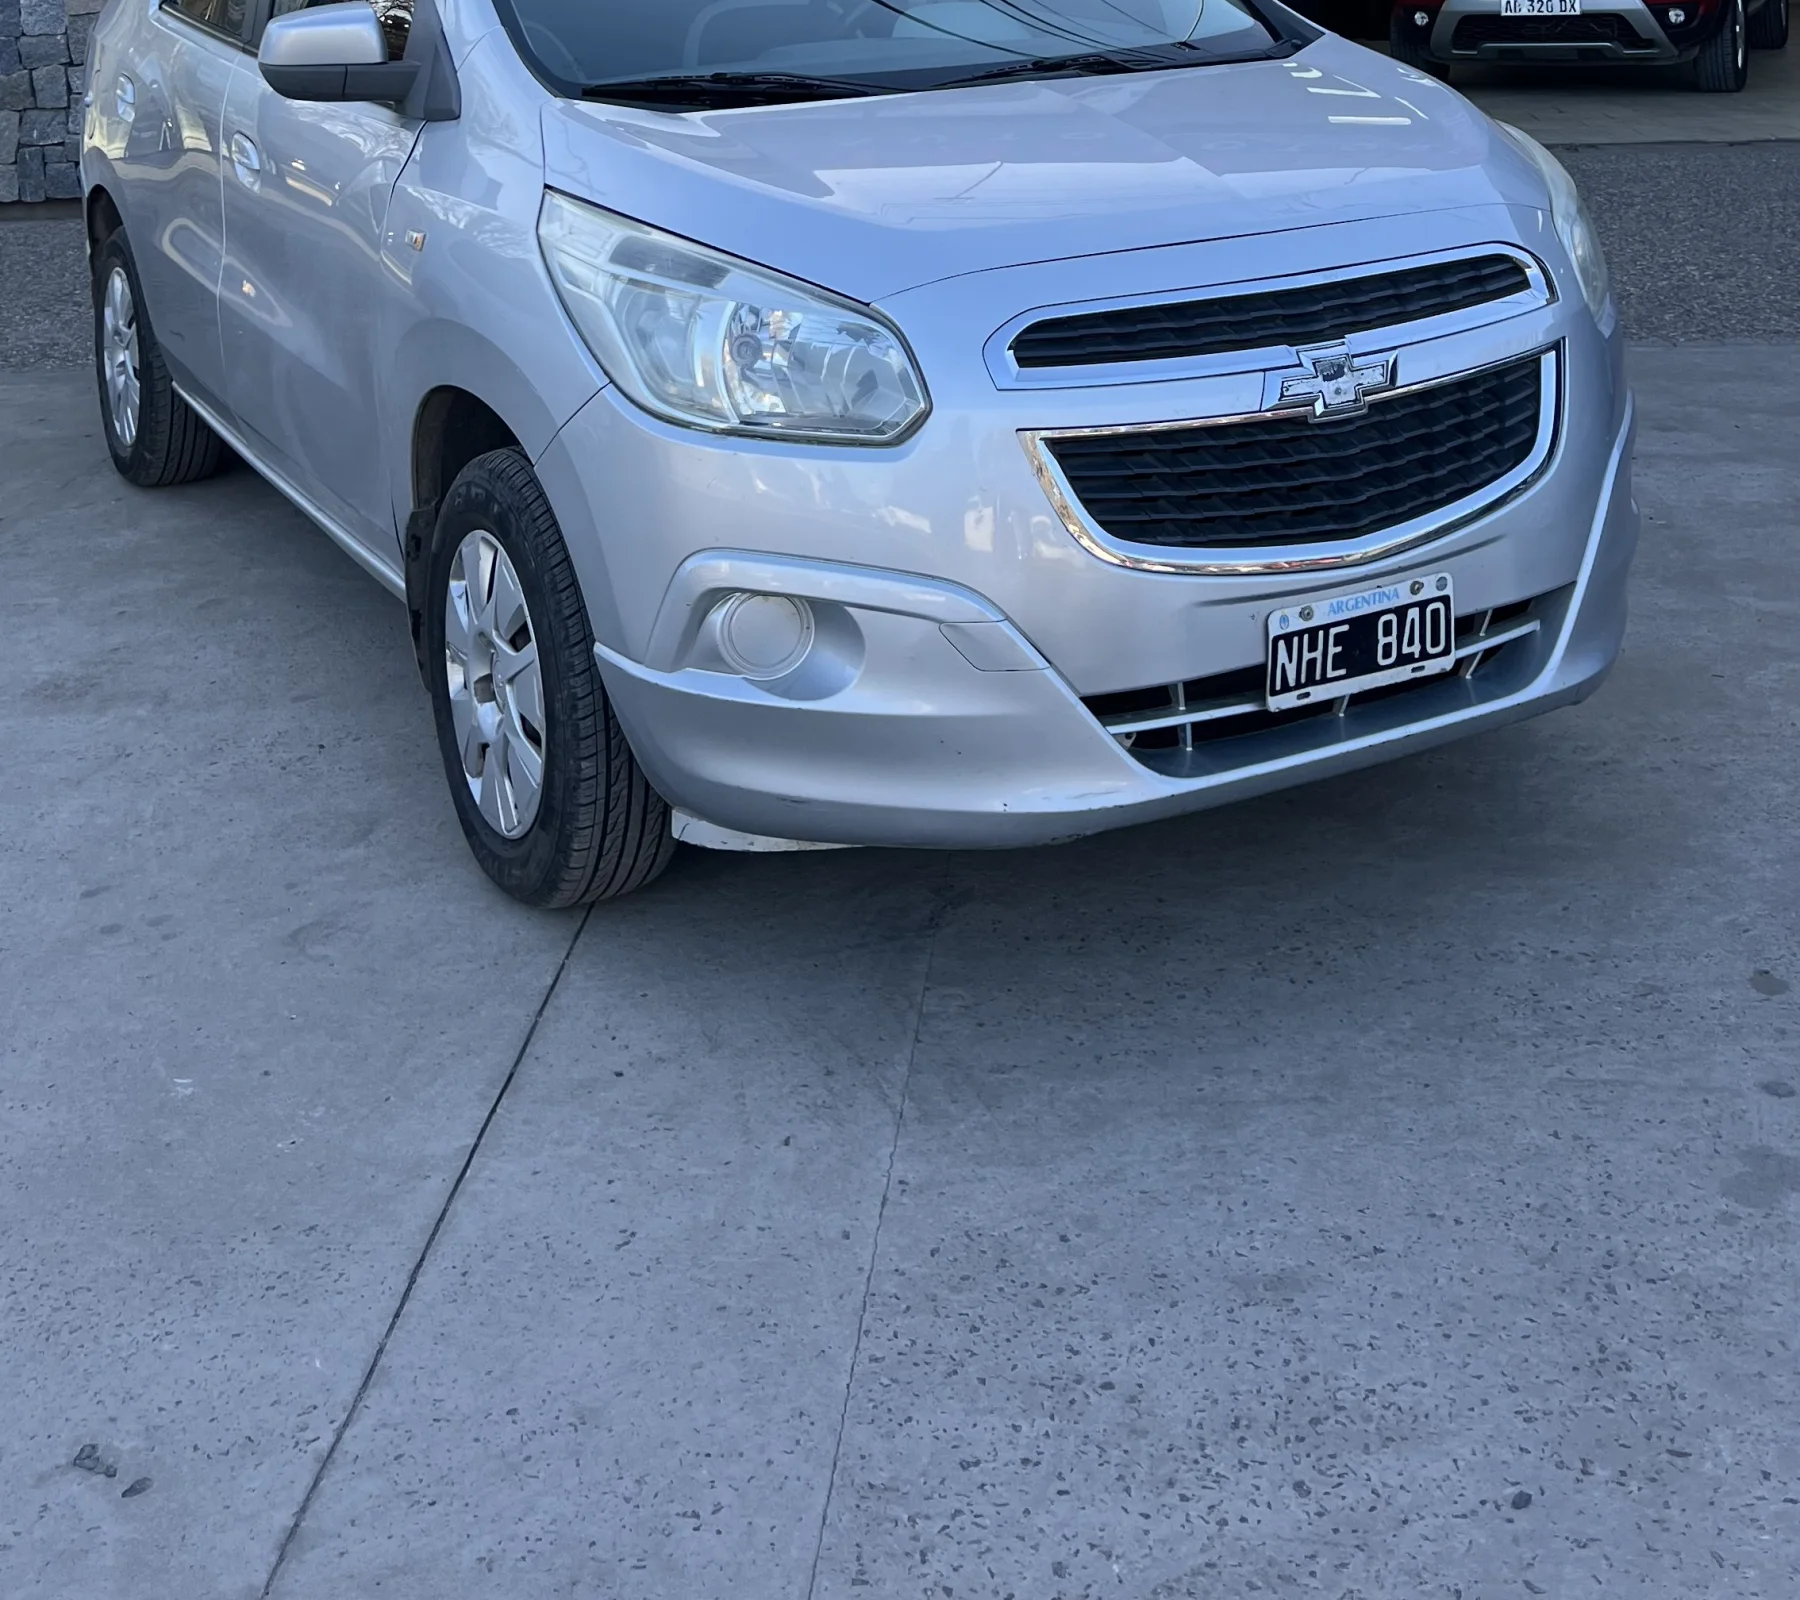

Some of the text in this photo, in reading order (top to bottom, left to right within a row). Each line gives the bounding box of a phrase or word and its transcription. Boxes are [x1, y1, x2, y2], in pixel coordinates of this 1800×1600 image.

[1327, 587, 1400, 616] ARGENTINA
[1275, 601, 1445, 691] NHE 840
